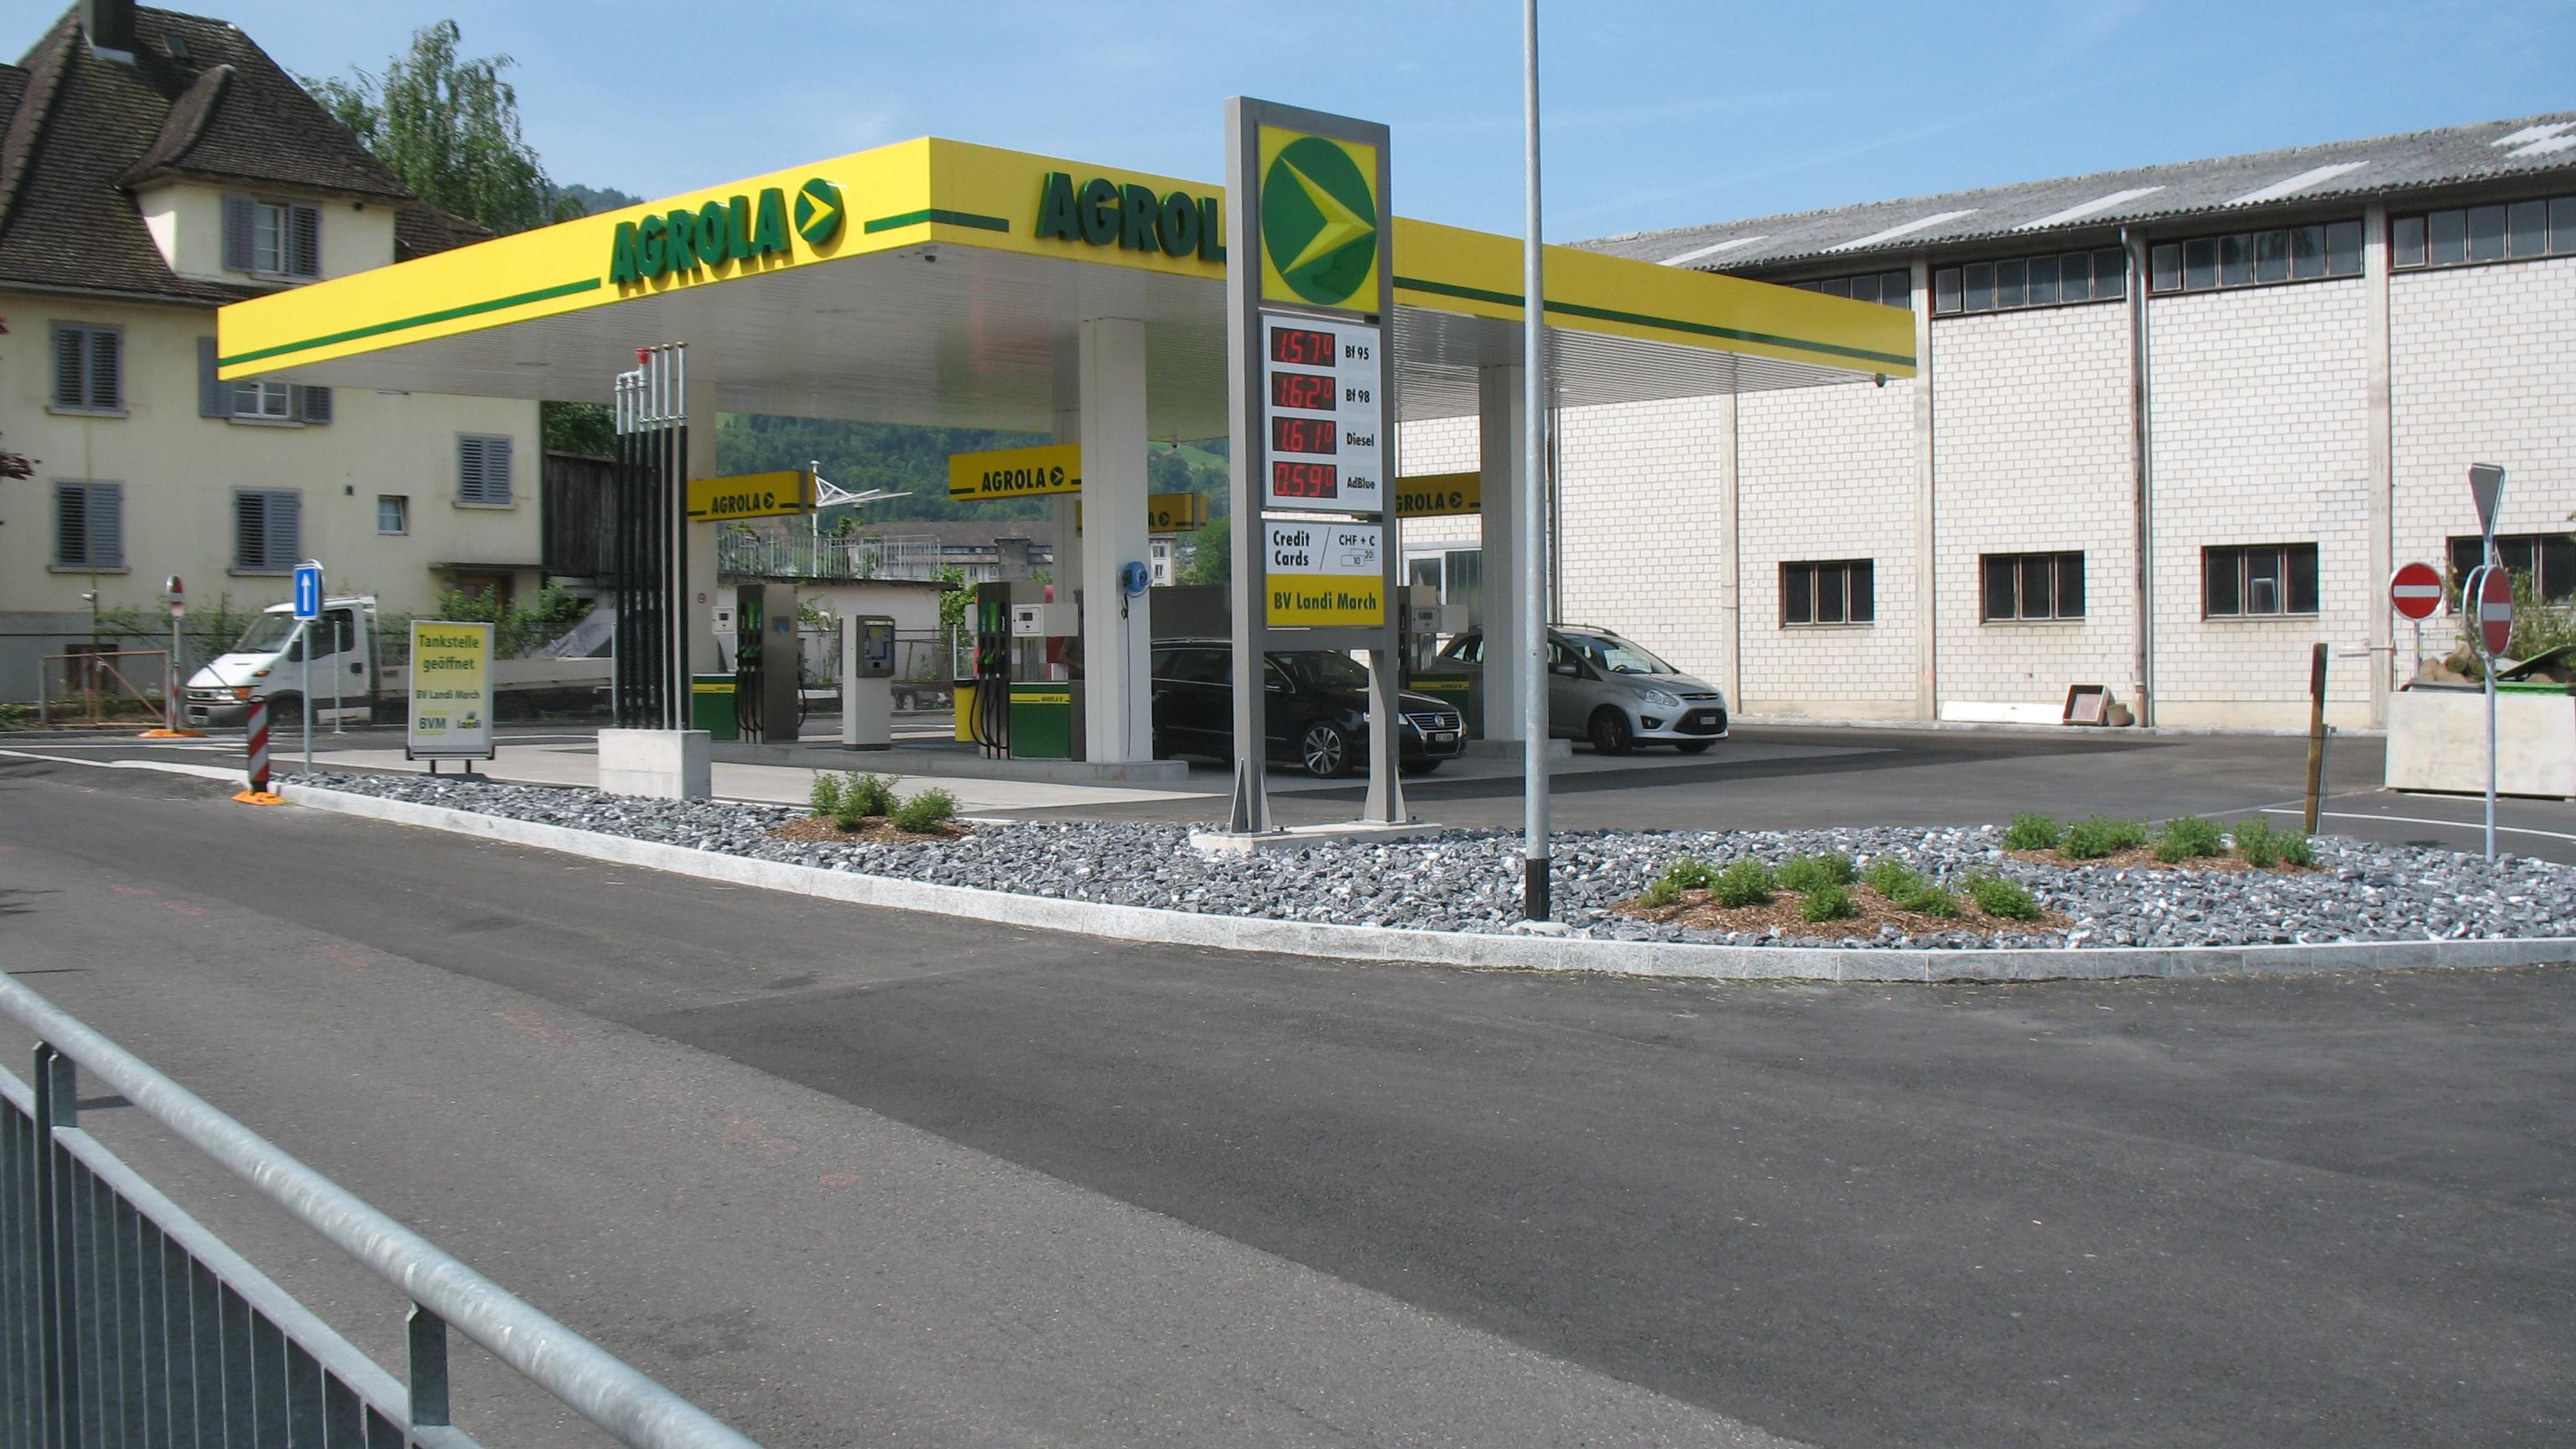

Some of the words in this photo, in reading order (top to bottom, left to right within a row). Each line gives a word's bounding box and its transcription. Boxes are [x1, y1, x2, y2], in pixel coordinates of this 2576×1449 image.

[1035, 172, 1227, 264] AGROL
[609, 187, 791, 283] AGROLA
[1345, 345, 1355, 359] Bf
[1358, 346, 1369, 360] 95
[1346, 388, 1356, 402] Bf
[1358, 390, 1370, 403] 98
[1347, 432, 1374, 447] Diesel
[981, 467, 1046, 492] AGROLA
[1347, 476, 1375, 489] AdBlue
[711, 492, 761, 515] AGROLA
[1395, 492, 1446, 513] GROLA
[1273, 530, 1310, 547] Credit
[1338, 534, 1358, 546] CHF
[1275, 550, 1309, 566] Cards
[1353, 557, 1361, 565] 10
[1364, 550, 1374, 559] 20
[1274, 592, 1291, 610] BV
[1296, 592, 1332, 610] Landi
[1337, 592, 1377, 610] March
[418, 634, 480, 649] Tankstelle
[423, 656, 475, 673] geöffnet
[418, 717, 446, 730] BVM
